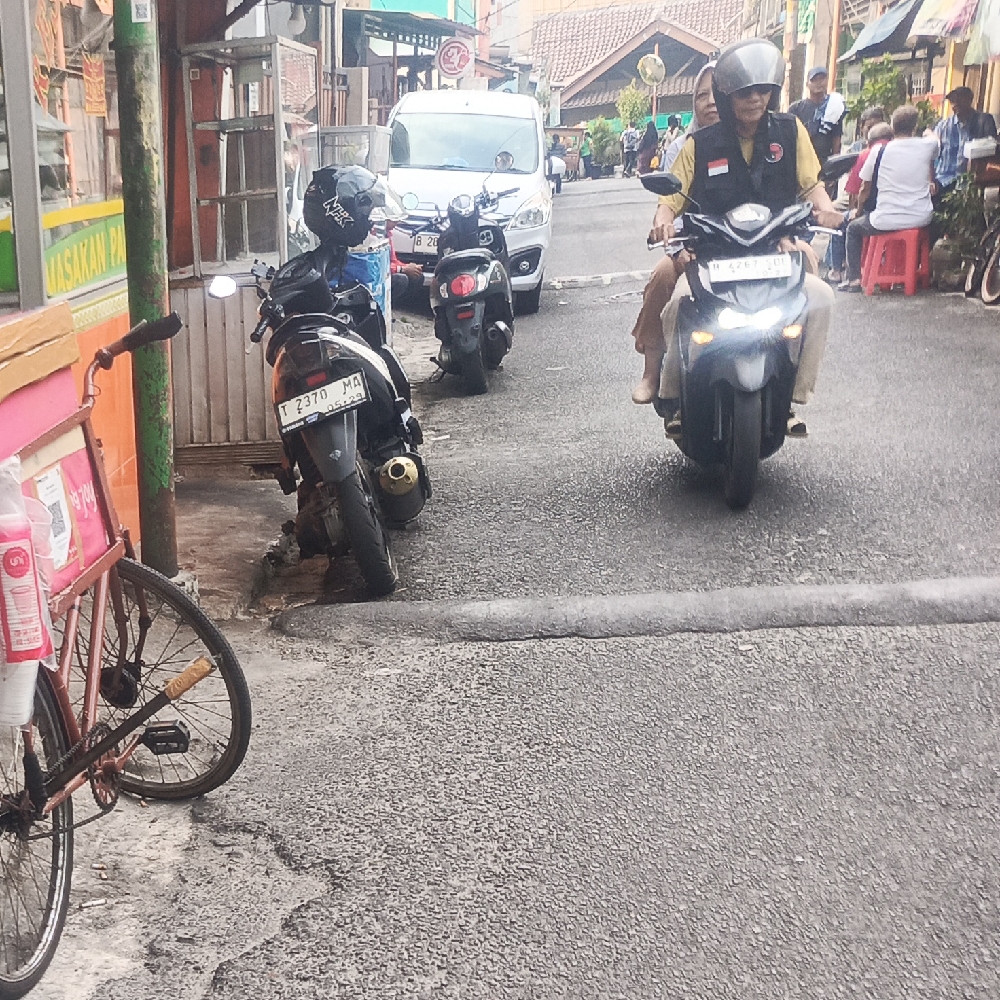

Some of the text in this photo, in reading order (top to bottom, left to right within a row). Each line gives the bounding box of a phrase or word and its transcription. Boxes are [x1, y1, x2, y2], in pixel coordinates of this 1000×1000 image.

[323, 195, 354, 228] NHK
[281, 404, 287, 416] T
[296, 388, 328, 411] 2370
